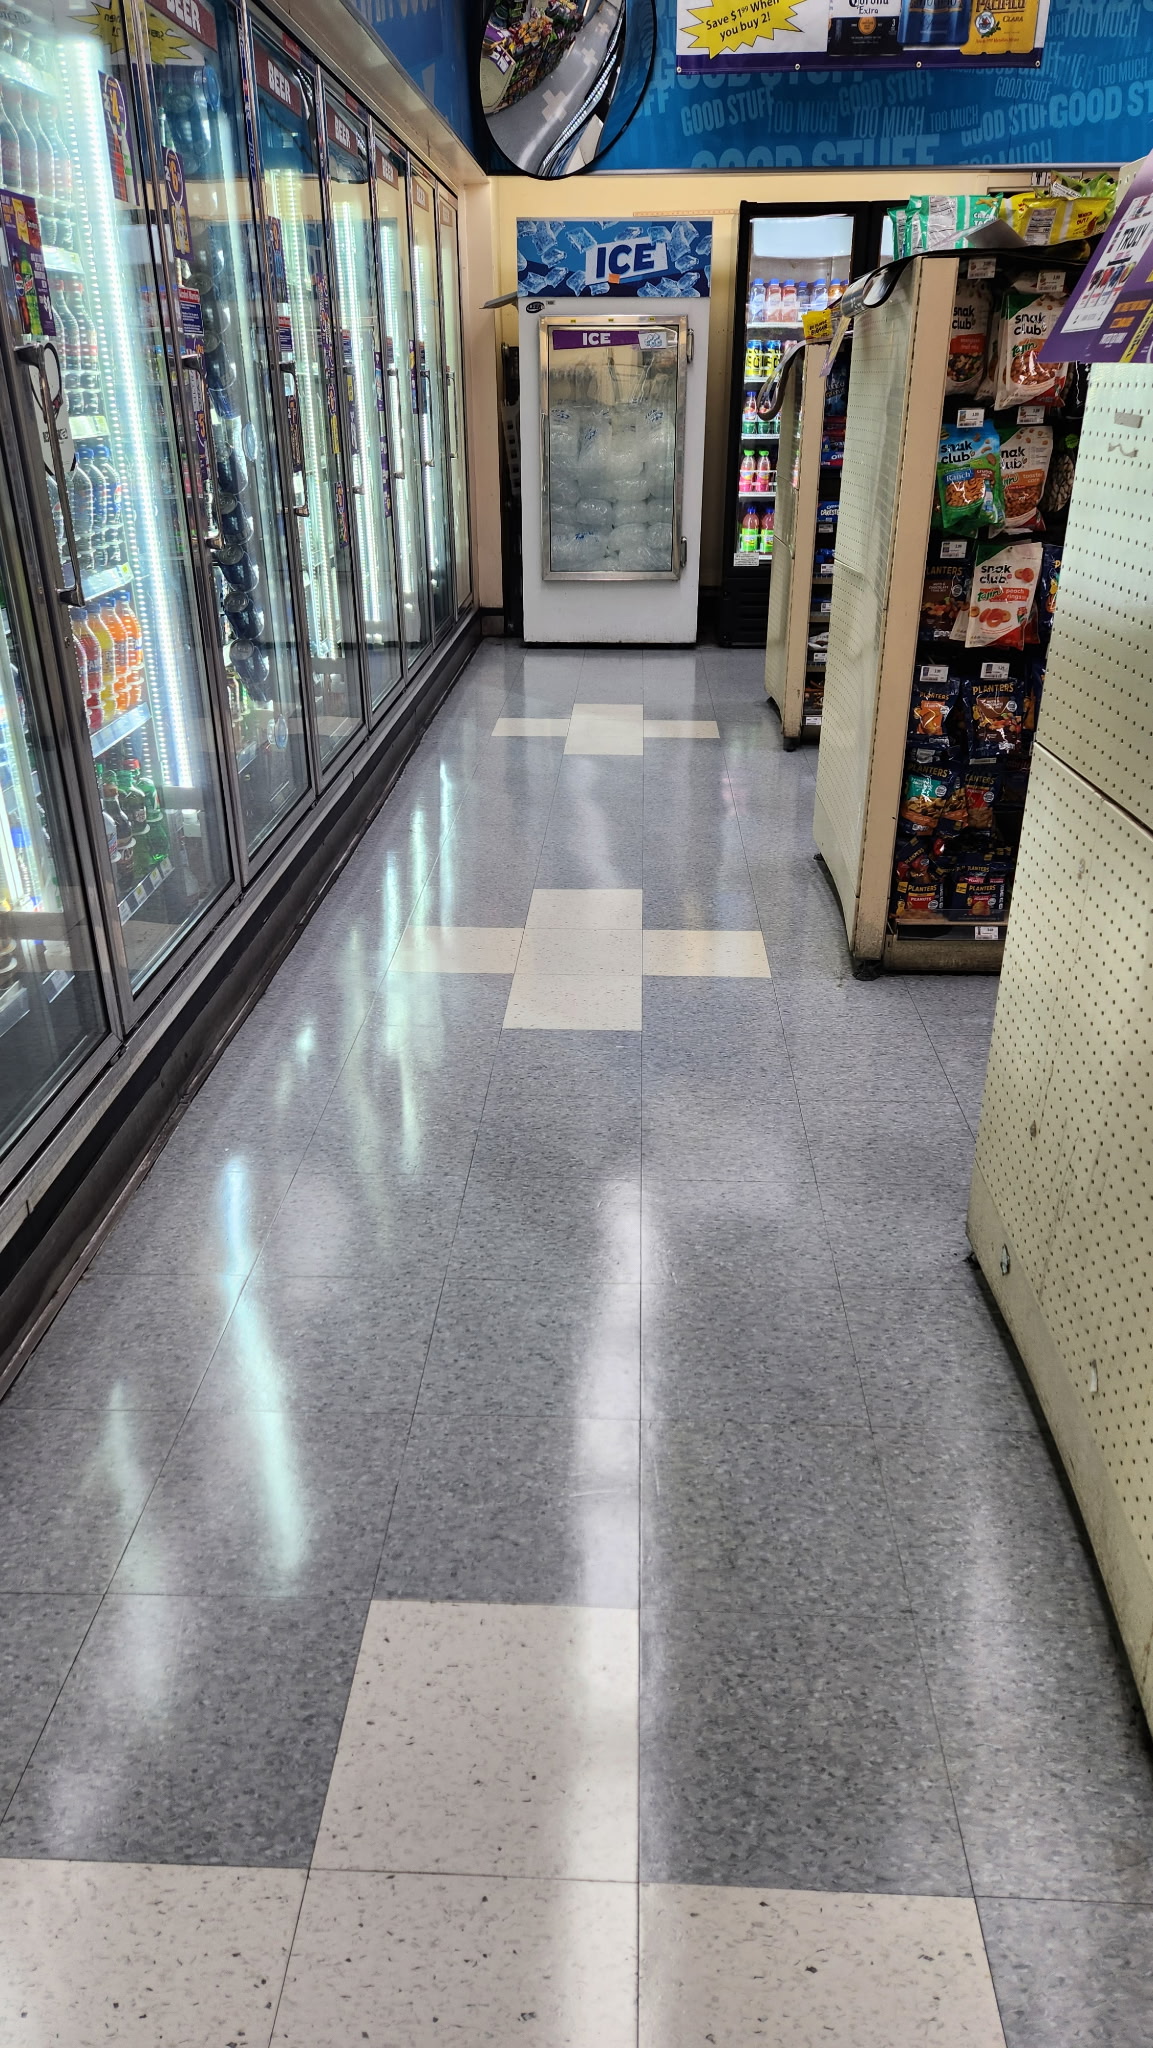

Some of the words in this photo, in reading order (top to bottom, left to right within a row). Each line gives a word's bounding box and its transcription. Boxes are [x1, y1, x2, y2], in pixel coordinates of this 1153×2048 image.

[166, 0, 201, 35] BEER
[706, 16, 730, 31] Save
[1095, 3, 1142, 38] MUCH
[719, 24, 739, 42] you
[740, 17, 759, 33] buy
[761, 12, 771, 24] 2!
[1097, 65, 1117, 86] TOO
[1119, 57, 1148, 84] MUCH
[267, 60, 291, 105] BEER
[995, 77, 1022, 99] GOOD
[681, 99, 725, 137] GOOD
[726, 86, 775, 126] STUFF
[1051, 86, 1122, 129] GOOD
[882, 106, 925, 138] MUCH
[930, 111, 948, 133] TOO
[950, 104, 979, 129] MUCH
[335, 115, 351, 149] BEER
[595, 243, 657, 280] ICE
[953, 305, 975, 317] snak
[1014, 312, 1046, 324] snak
[952, 318, 973, 330] club
[1014, 323, 1042, 336] club
[582, 332, 611, 346] ICE
[940, 441, 972, 453] snak
[1000, 446, 1025, 458] nak
[941, 452, 970, 465] club
[926, 566, 963, 576] LANTERS
[981, 565, 1012, 574] snak
[980, 574, 1007, 584] club
[919, 691, 950, 701] PLANTERS
[972, 683, 1015, 696] PLANTERS
[908, 763, 949, 779] PLANTERS
[908, 884, 937, 892] PLANTERS
[968, 884, 997, 892] PLANTERS
